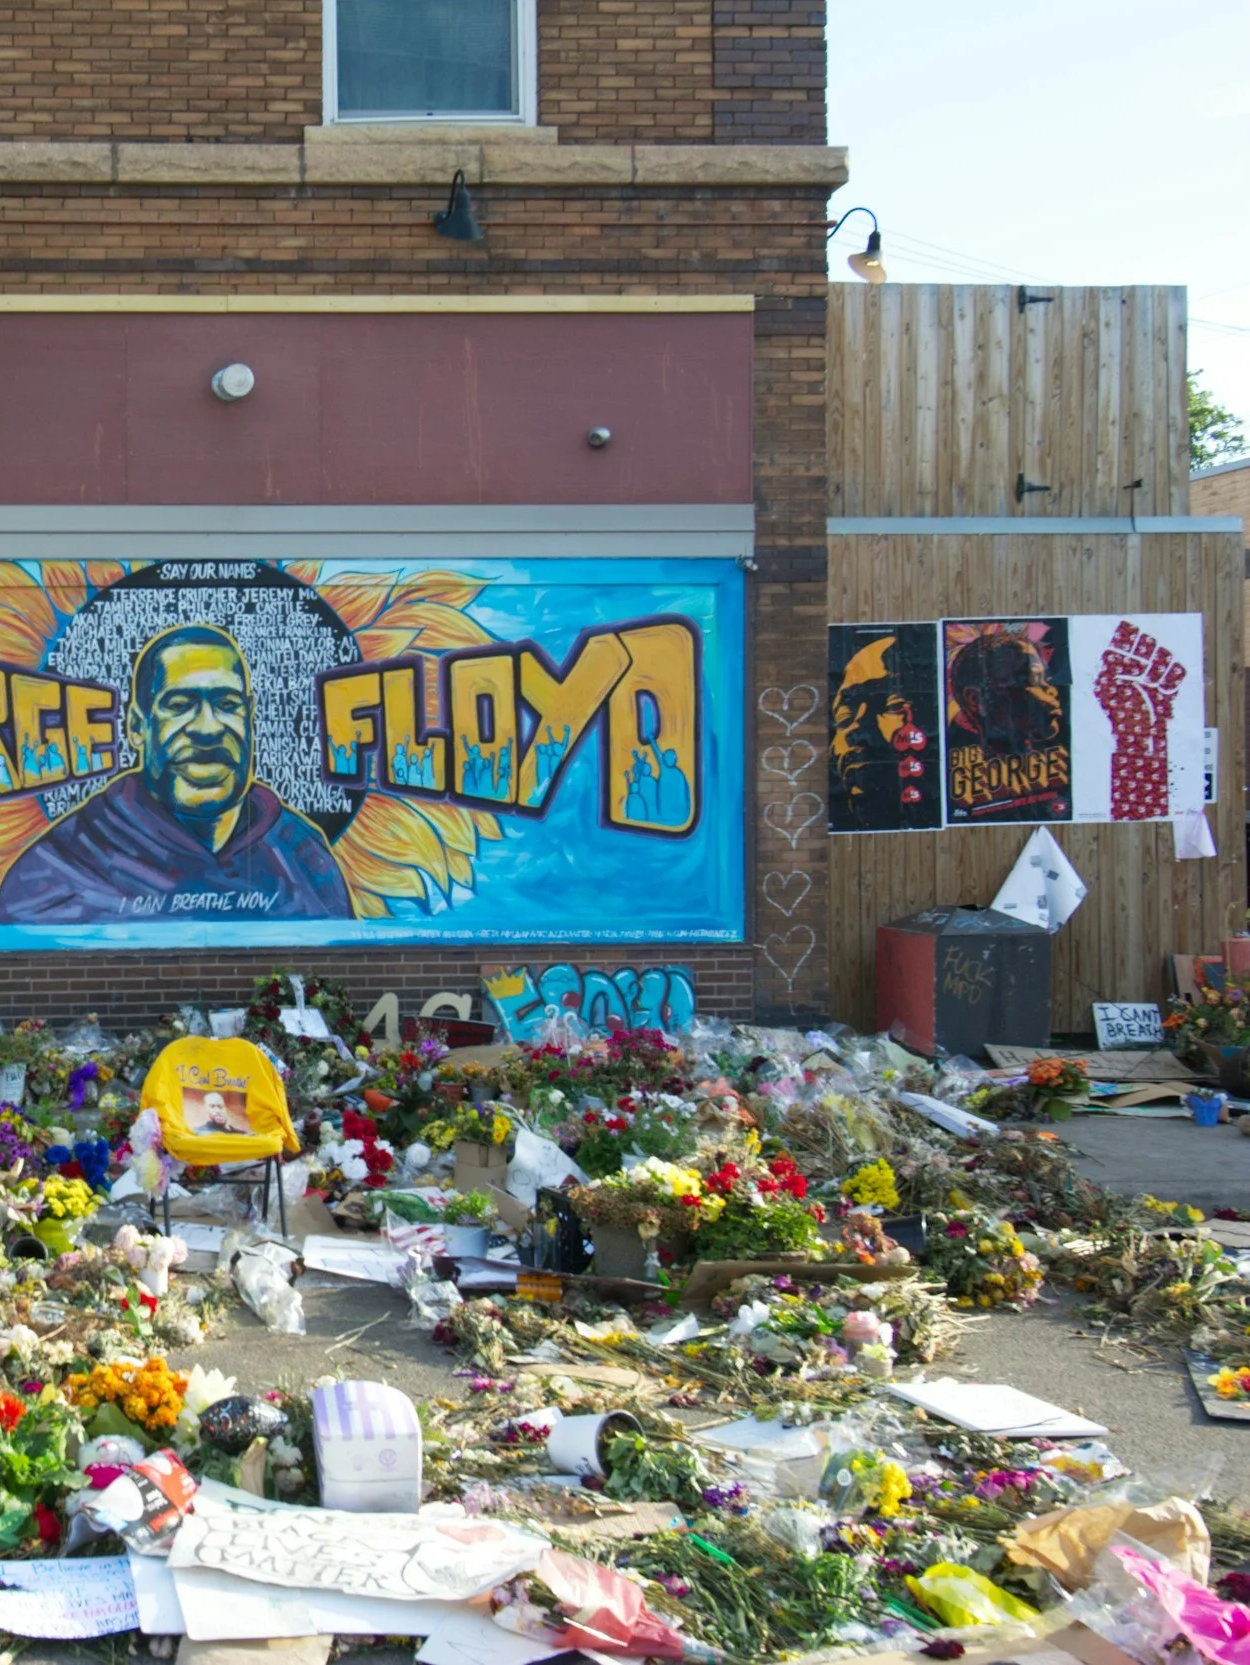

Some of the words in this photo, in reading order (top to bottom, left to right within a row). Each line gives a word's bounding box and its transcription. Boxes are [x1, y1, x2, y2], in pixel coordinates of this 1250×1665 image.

[159, 562, 189, 580] SAY
[190, 562, 218, 580] OUR
[219, 562, 257, 579] NAMES
[110, 588, 176, 603] TERRENCE
[178, 587, 238, 603] CRUTCHER
[242, 587, 294, 603] JEREMY
[178, 600, 245, 615] PHILANDO
[255, 601, 305, 615] CASTILE
[71, 613, 99, 627] AKAI
[140, 613, 186, 627] KENDRA
[186, 613, 226, 627] JAMES
[234, 613, 284, 627] FREDDIE
[286, 613, 320, 627] GREY
[65, 625, 119, 639] MICHAEL
[57, 638, 100, 653] TYISHA
[238, 638, 291, 651] BREONNA
[291, 638, 336, 651] TAYLOR
[48, 652, 77, 666] ERIC
[77, 652, 131, 666] GARNER
[244, 650, 298, 664] SHANTEL
[299, 650, 335, 663] DAVIS
[57, 664, 108, 680] SANDRA
[251, 677, 285, 691] REKIA
[255, 705, 299, 720] SHELLY
[320, 617, 698, 836] FLOYD
[254, 737, 308, 752] TANISHA
[950, 744, 982, 768] BIG
[254, 765, 296, 781] ALTON
[950, 746, 1067, 802] GEORGE
[287, 799, 352, 813] KATHRYN
[117, 896, 127, 914] I
[131, 893, 168, 914] CAN
[168, 891, 237, 913] BREATHE
[236, 891, 280, 913] NOW
[943, 945, 994, 988] FUCK
[943, 972, 982, 1004] MPD
[1098, 1006, 1115, 1022] I
[219, 1547, 390, 1591] MATTER
